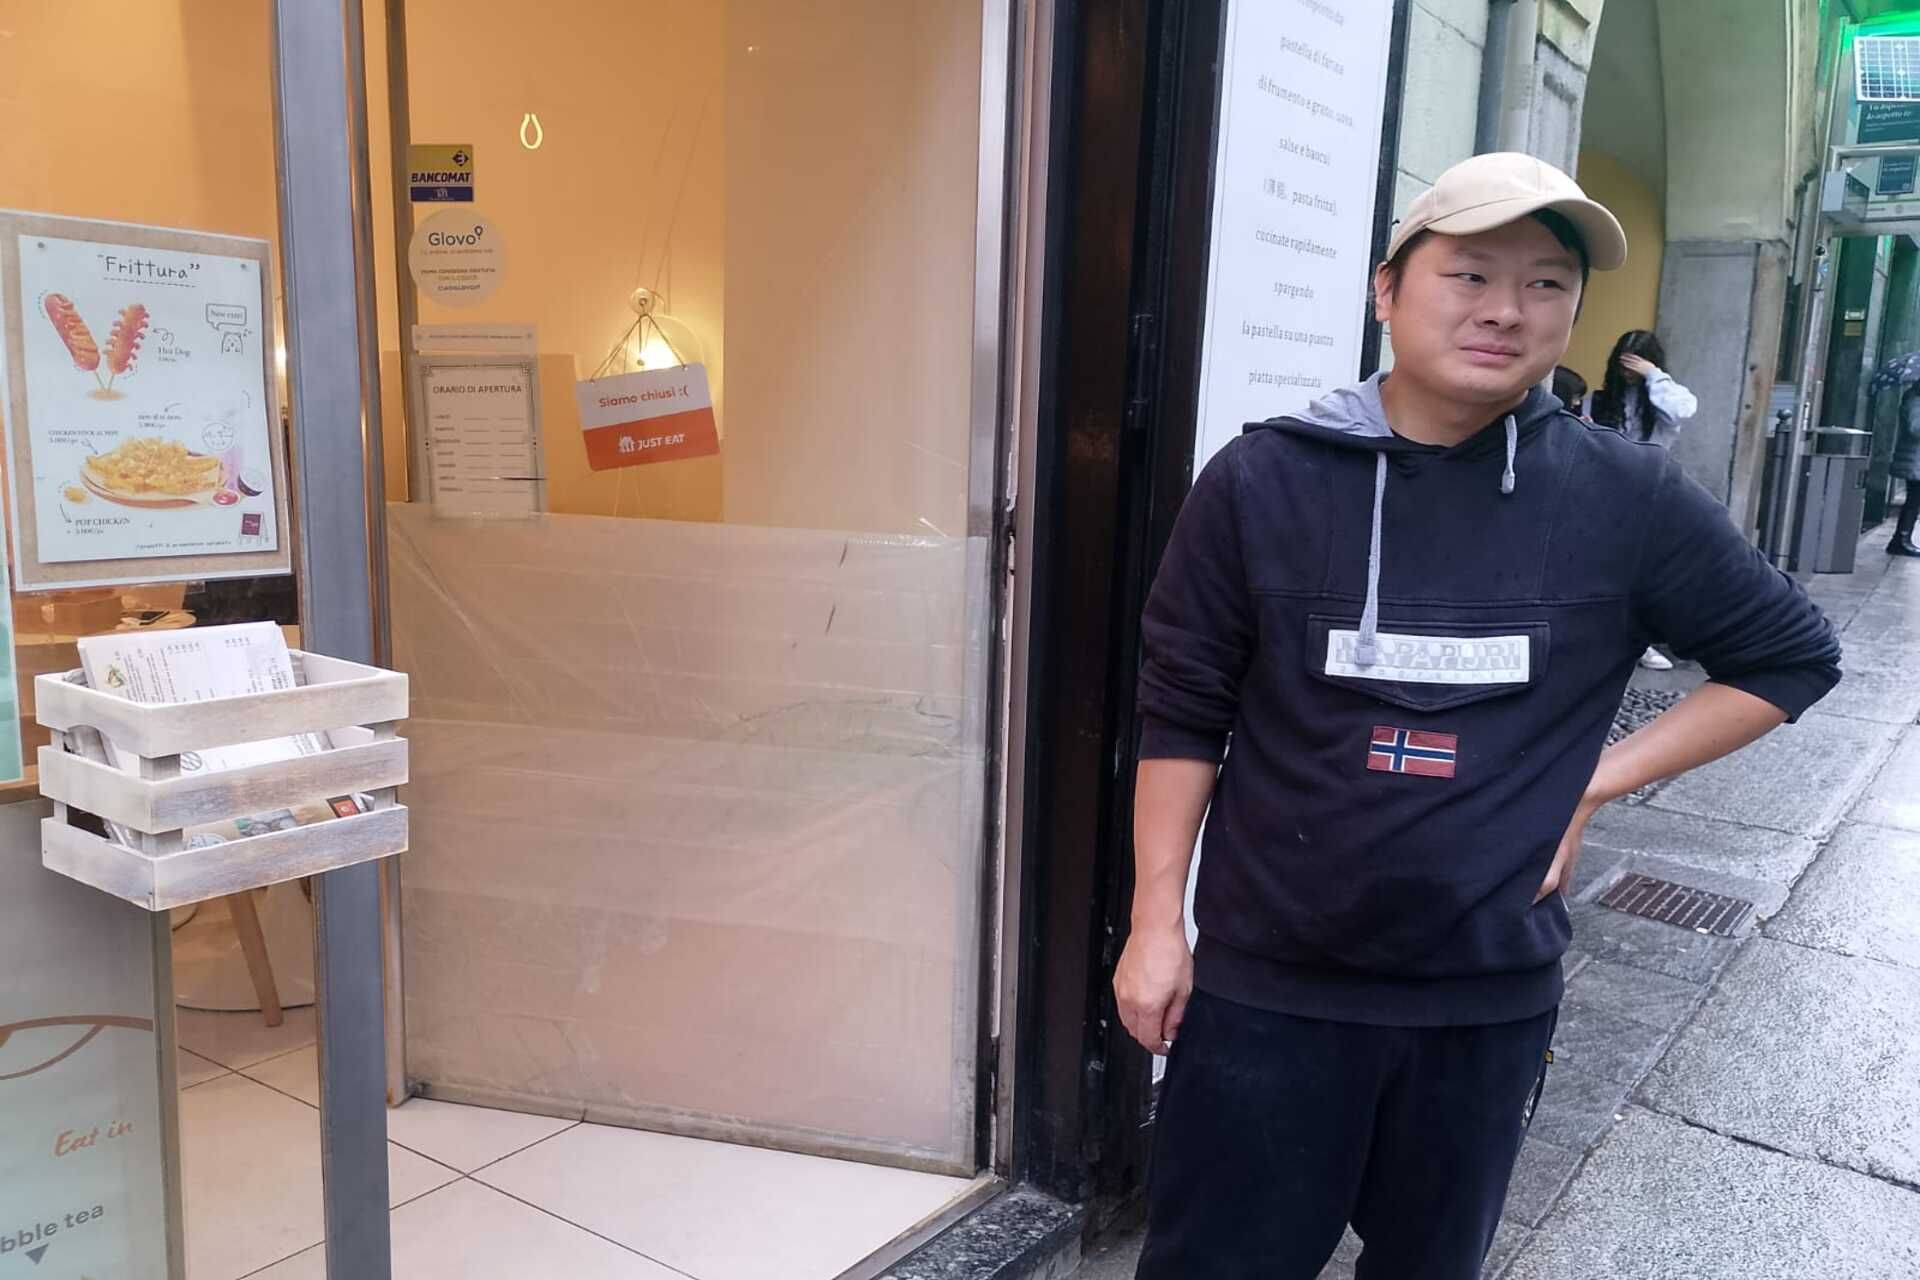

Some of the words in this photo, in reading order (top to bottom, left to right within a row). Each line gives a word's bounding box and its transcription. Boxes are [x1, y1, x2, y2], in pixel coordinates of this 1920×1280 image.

[411, 172, 471, 183] BANCOMAT
[428, 231, 477, 246] Glovo
[1273, 281, 1314, 300] spargendo
[1251, 324, 1283, 341] pastella
[432, 385, 466, 394] ORARIO
[467, 385, 476, 394] DI
[478, 385, 522, 394] APERTURA
[598, 394, 638, 408] Siamo
[641, 386, 676, 402] chiusi
[637, 436, 663, 451] JUST
[664, 433, 685, 446] EAT
[54, 1127, 97, 1158] Eat
[107, 1119, 134, 1139] in
[63, 1204, 105, 1229] tea
